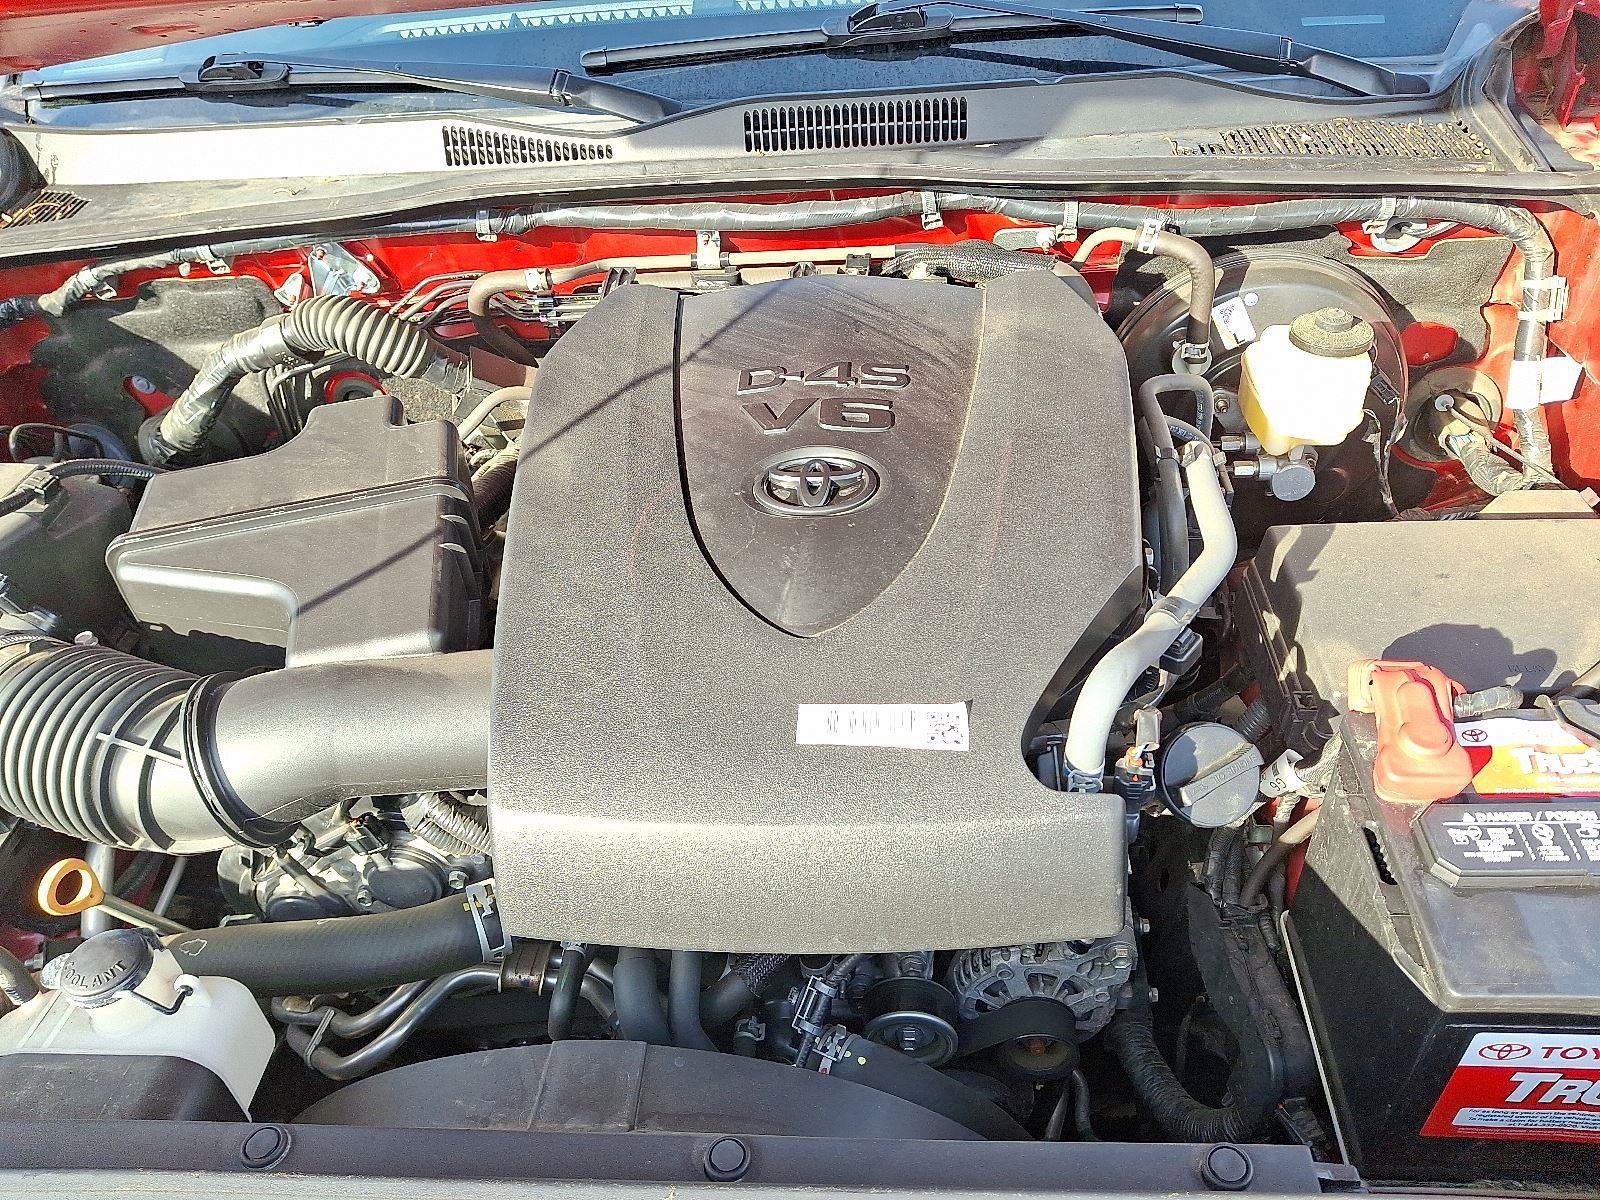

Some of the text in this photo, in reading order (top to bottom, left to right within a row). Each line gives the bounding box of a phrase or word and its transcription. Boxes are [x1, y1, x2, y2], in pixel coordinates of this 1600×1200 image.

[737, 361, 912, 395] D-4S
[741, 397, 896, 434] V6
[65, 959, 128, 989] COOLANT
